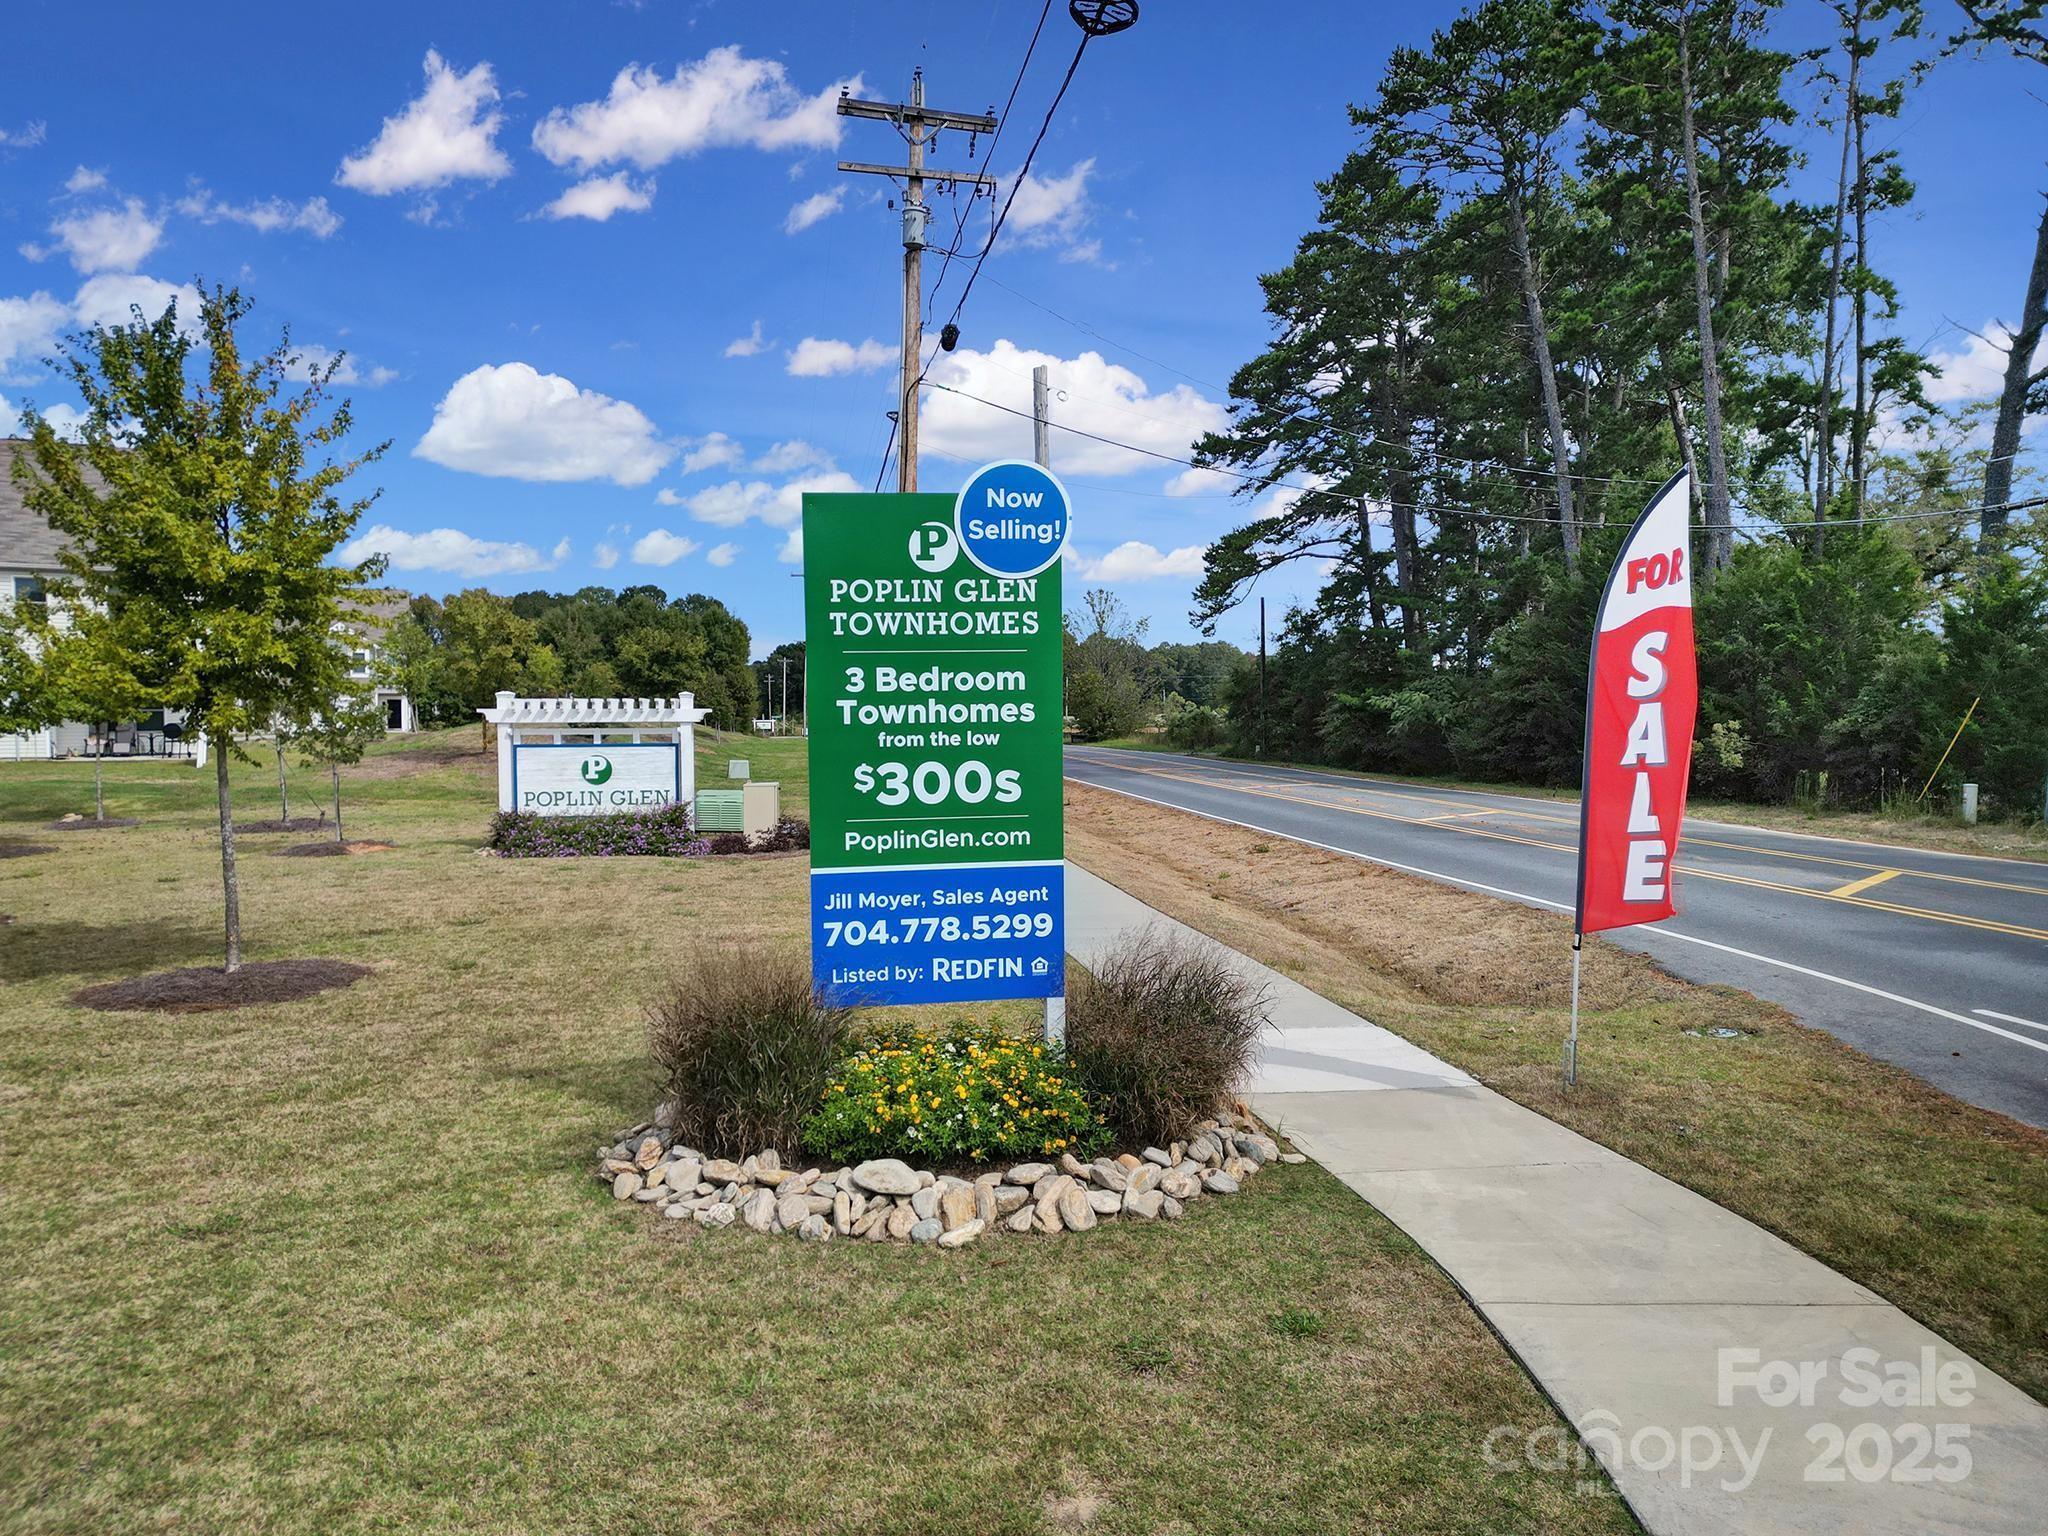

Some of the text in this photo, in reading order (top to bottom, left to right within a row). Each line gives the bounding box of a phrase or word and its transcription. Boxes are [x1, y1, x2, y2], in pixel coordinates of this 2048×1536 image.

[986, 488, 1043, 508] Now
[915, 525, 949, 561] P
[968, 519, 1061, 544] Selling!
[1626, 547, 1684, 595] FOR
[829, 578, 1038, 603] POPLIN GLEN
[829, 611, 1039, 635] TOWNHOMES
[844, 665, 1026, 693] 3 Bedroom
[836, 698, 1036, 725] Townhomes
[878, 731, 1000, 748] from the low
[585, 755, 607, 779] P
[1619, 630, 1668, 902] SALE
[853, 760, 1022, 806] $300s
[524, 789, 670, 807] POPLIN GLEN
[844, 829, 1031, 854] PoplinGlen.com
[824, 886, 1049, 911] Jill Moyer, Sales Agent
[823, 913, 1053, 947] 704.778.5299
[832, 957, 1023, 987] Listed by: REDFIN
